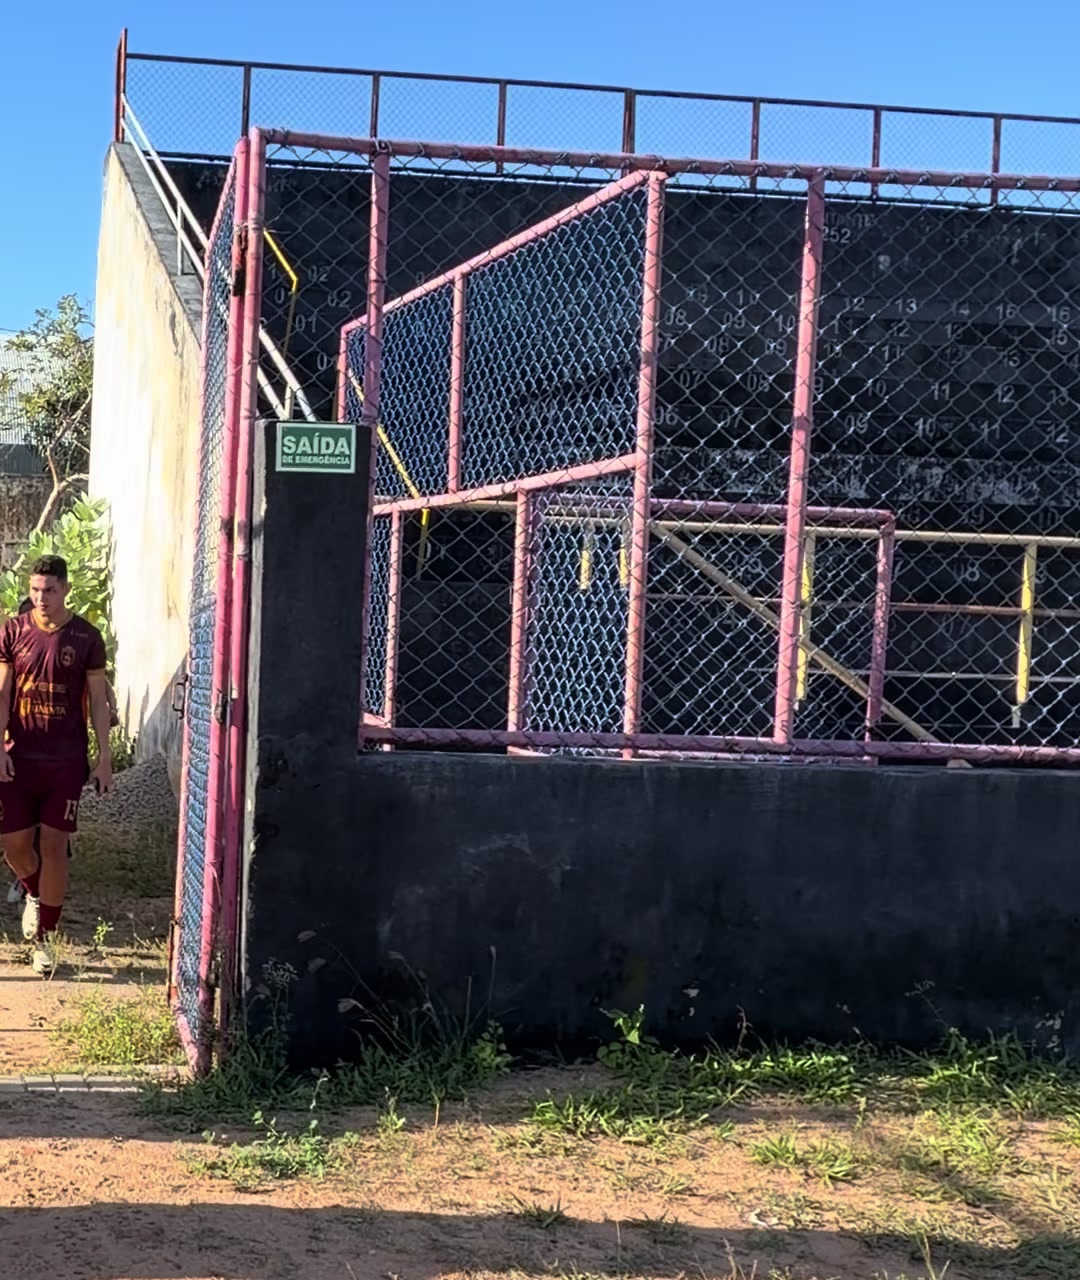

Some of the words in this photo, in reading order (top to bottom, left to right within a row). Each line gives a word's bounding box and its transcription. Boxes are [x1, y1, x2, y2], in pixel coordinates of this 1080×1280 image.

[894, 298, 918, 314] 13
[665, 309, 687, 326] 08
[282, 432, 350, 455] SAÍDA
[282, 455, 293, 463] DE
[295, 455, 350, 464] EMERGÊNCIA
[63, 799, 77, 821] 13
